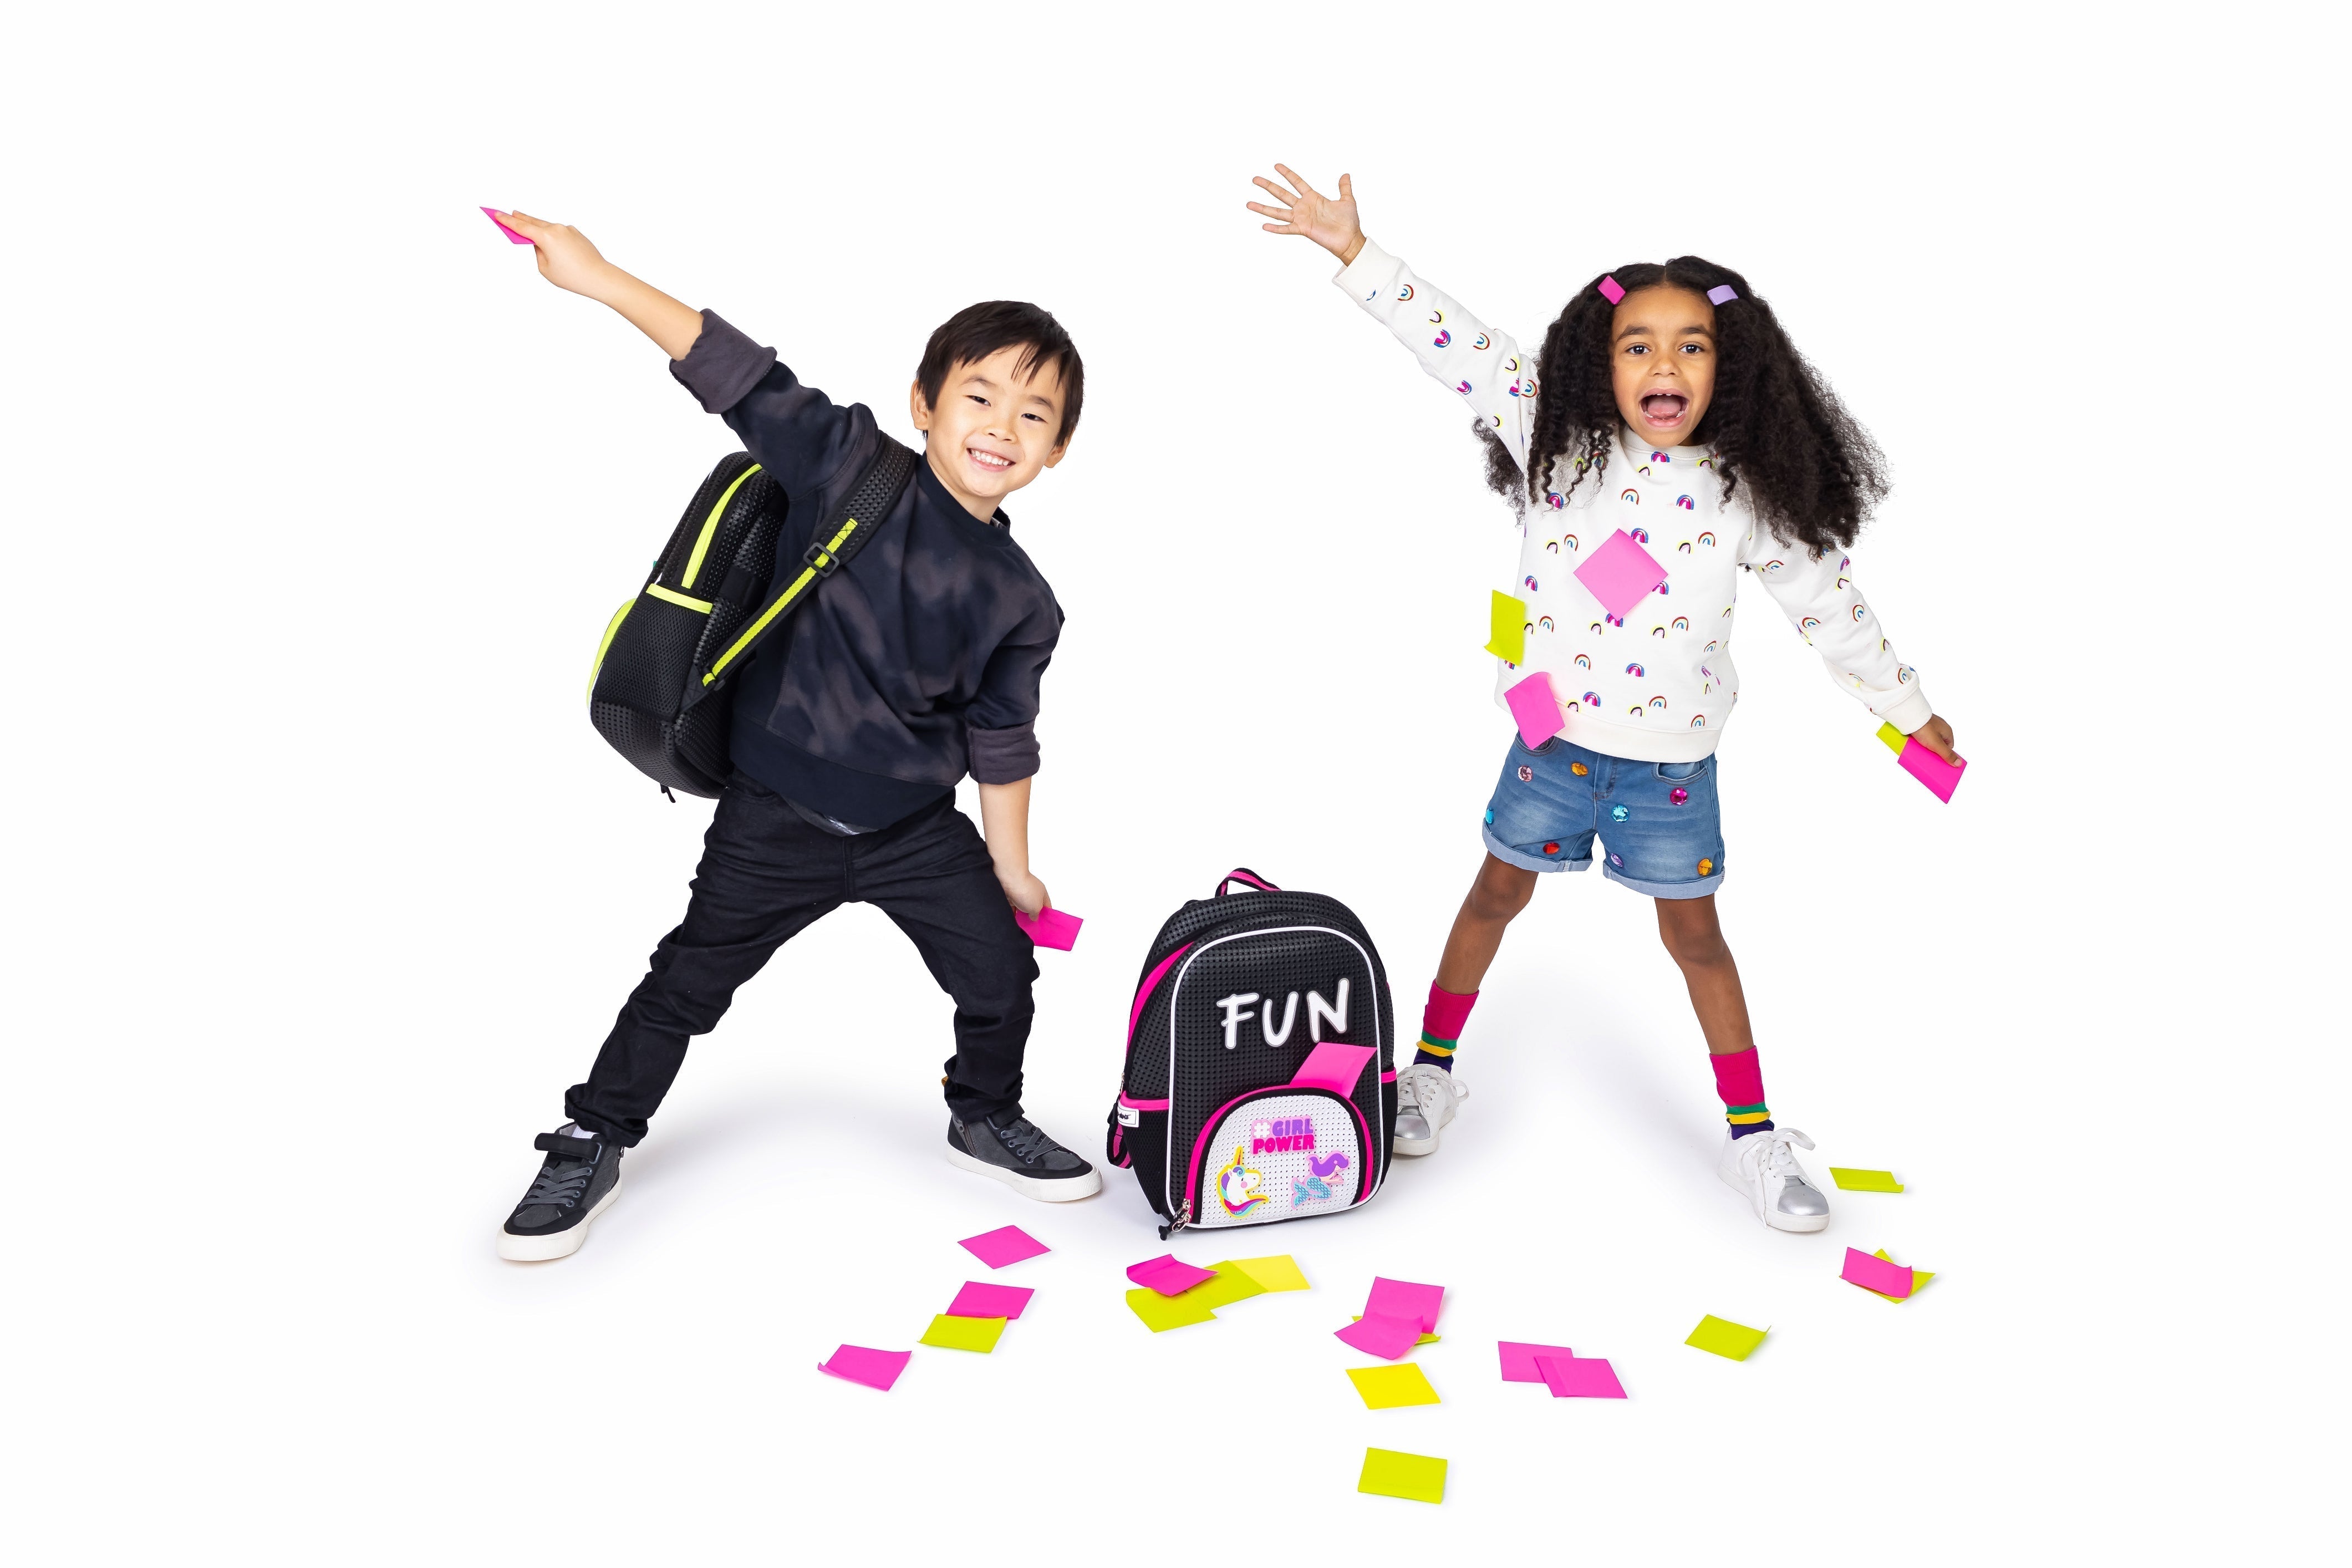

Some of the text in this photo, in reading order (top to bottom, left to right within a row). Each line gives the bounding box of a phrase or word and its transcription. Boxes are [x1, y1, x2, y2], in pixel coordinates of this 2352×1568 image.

[1216, 978, 1350, 1049] FUN
[1253, 1118, 1314, 1138] #GIRL
[1253, 1134, 1315, 1154] POWER
